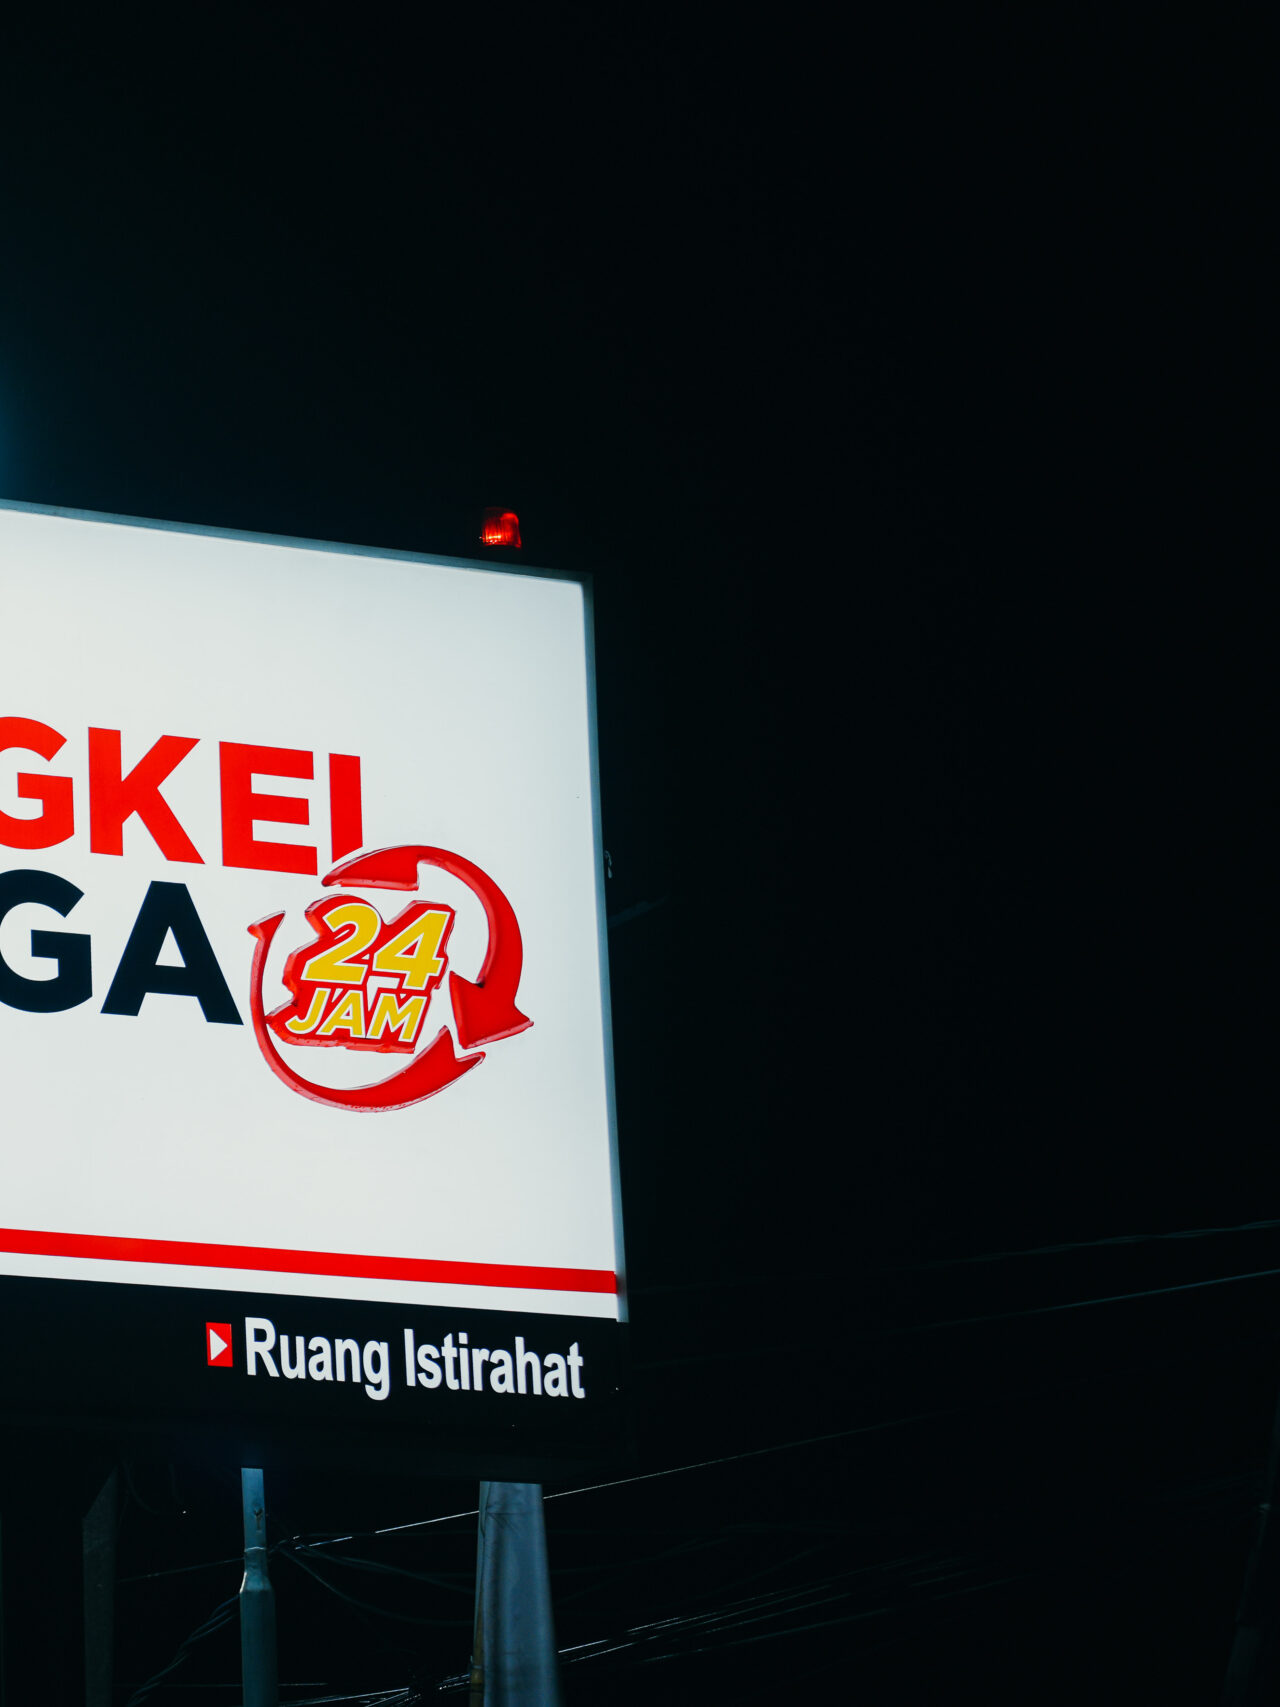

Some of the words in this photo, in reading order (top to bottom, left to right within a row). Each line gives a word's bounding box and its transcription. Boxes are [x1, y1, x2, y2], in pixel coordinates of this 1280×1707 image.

[301, 903, 450, 990] 24
[285, 987, 427, 1042] JAM
[244, 1316, 390, 1401] Ruang
[403, 1328, 586, 1399] Istirahat
